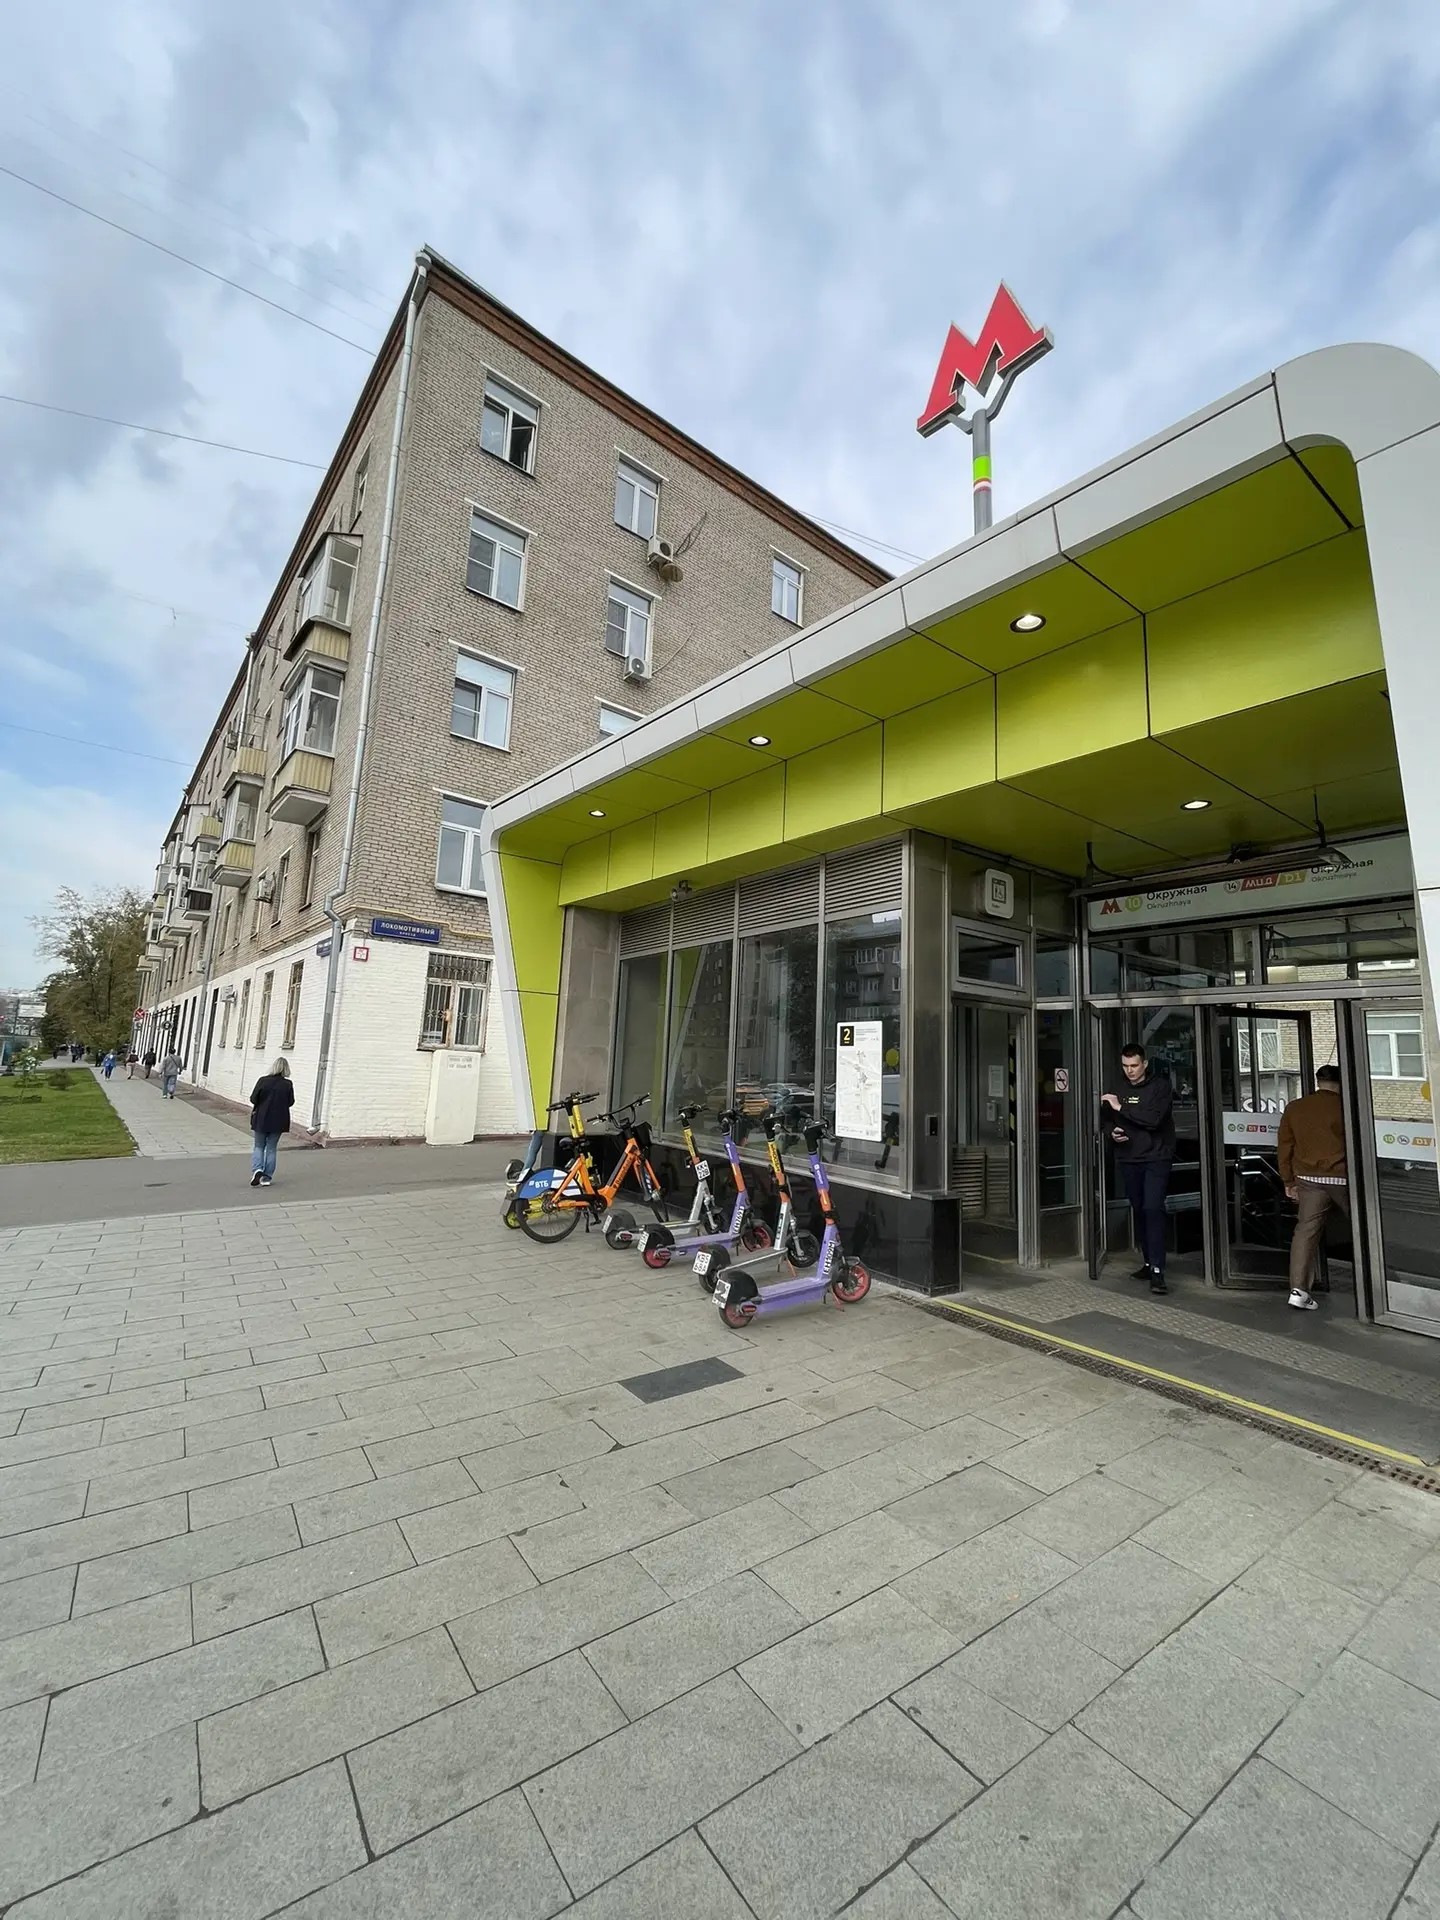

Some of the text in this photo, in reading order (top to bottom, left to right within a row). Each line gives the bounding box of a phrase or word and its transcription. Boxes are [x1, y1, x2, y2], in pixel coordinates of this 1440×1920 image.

[1146, 885, 1208, 901] Окружная
[380, 922, 436, 935] ЛОКОМОТИВНЫЙ
[843, 1028, 851, 1041] 2
[535, 1180, 549, 1188] ВТБ
